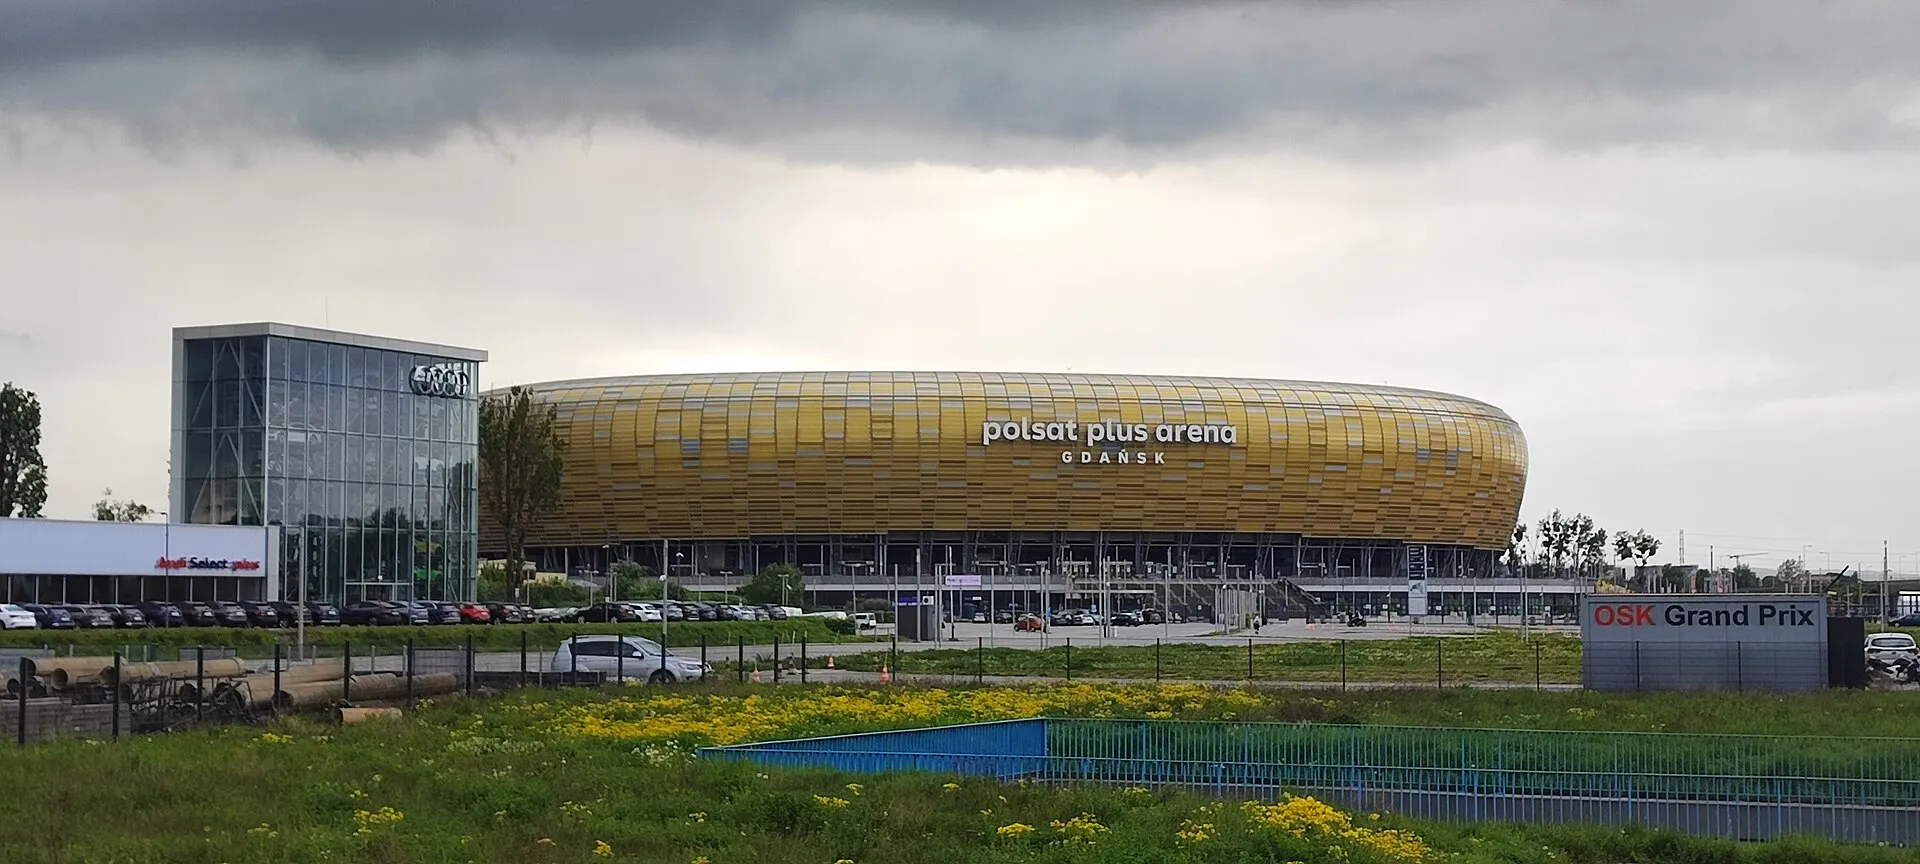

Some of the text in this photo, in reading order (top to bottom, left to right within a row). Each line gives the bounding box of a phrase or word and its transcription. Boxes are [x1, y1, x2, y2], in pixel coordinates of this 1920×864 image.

[983, 417, 1237, 446] polsat plus arena
[1061, 448, 1165, 464] GDAŃSK
[189, 557, 228, 569] Select
[1594, 604, 1815, 627] OSK Grand Prix
